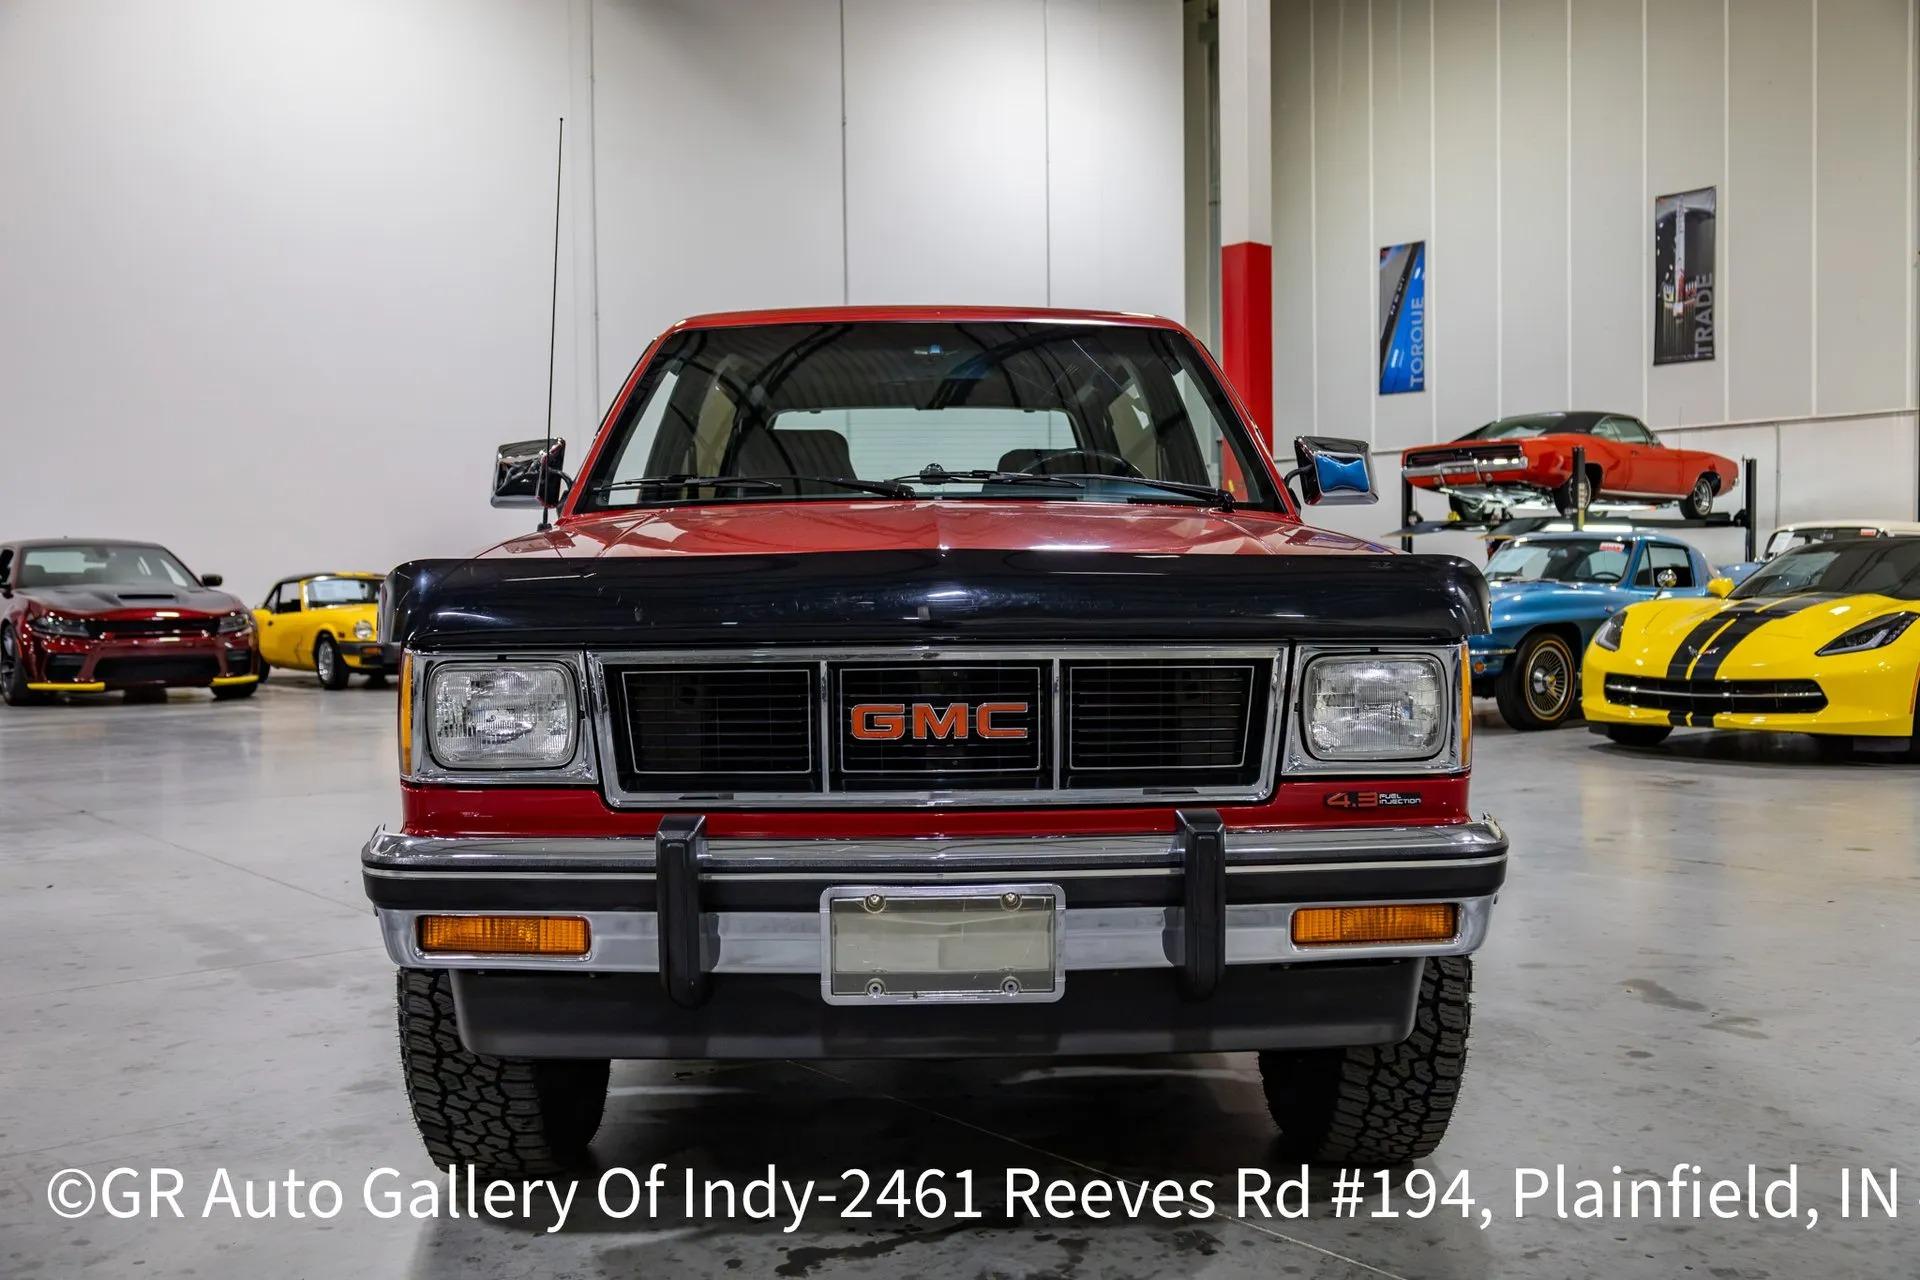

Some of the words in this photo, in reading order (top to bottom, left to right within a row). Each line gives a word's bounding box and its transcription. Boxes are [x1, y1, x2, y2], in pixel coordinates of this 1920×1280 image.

[1409, 295, 1425, 388] TORQUE
[850, 702, 1028, 740] GMC
[1326, 792, 1378, 808] 4.3
